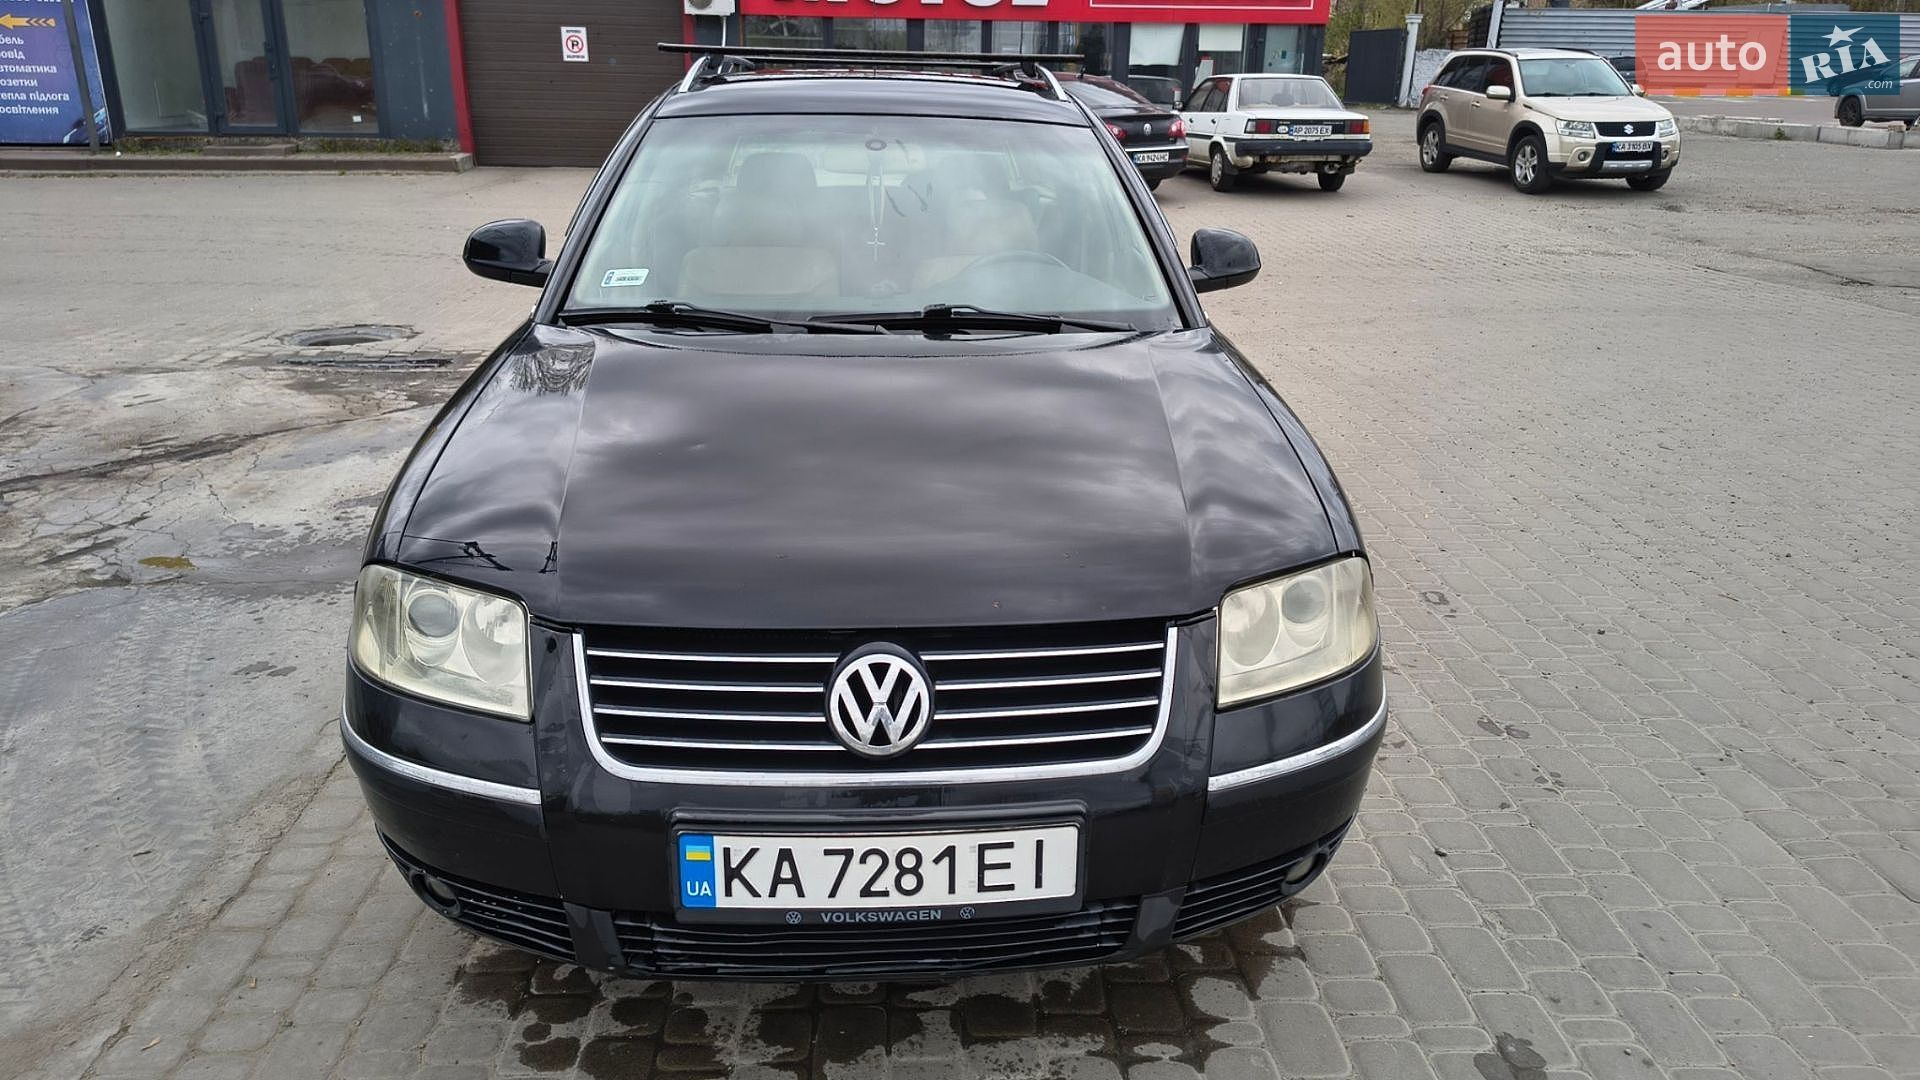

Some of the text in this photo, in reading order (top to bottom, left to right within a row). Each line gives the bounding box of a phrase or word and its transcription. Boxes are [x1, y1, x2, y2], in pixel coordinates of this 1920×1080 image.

[0, 91, 70, 101] епла підлога
[722, 839, 1044, 898] KA 7281 EI
[686, 881, 712, 897] UA
[820, 909, 942, 923] VOLKSWAGEN
